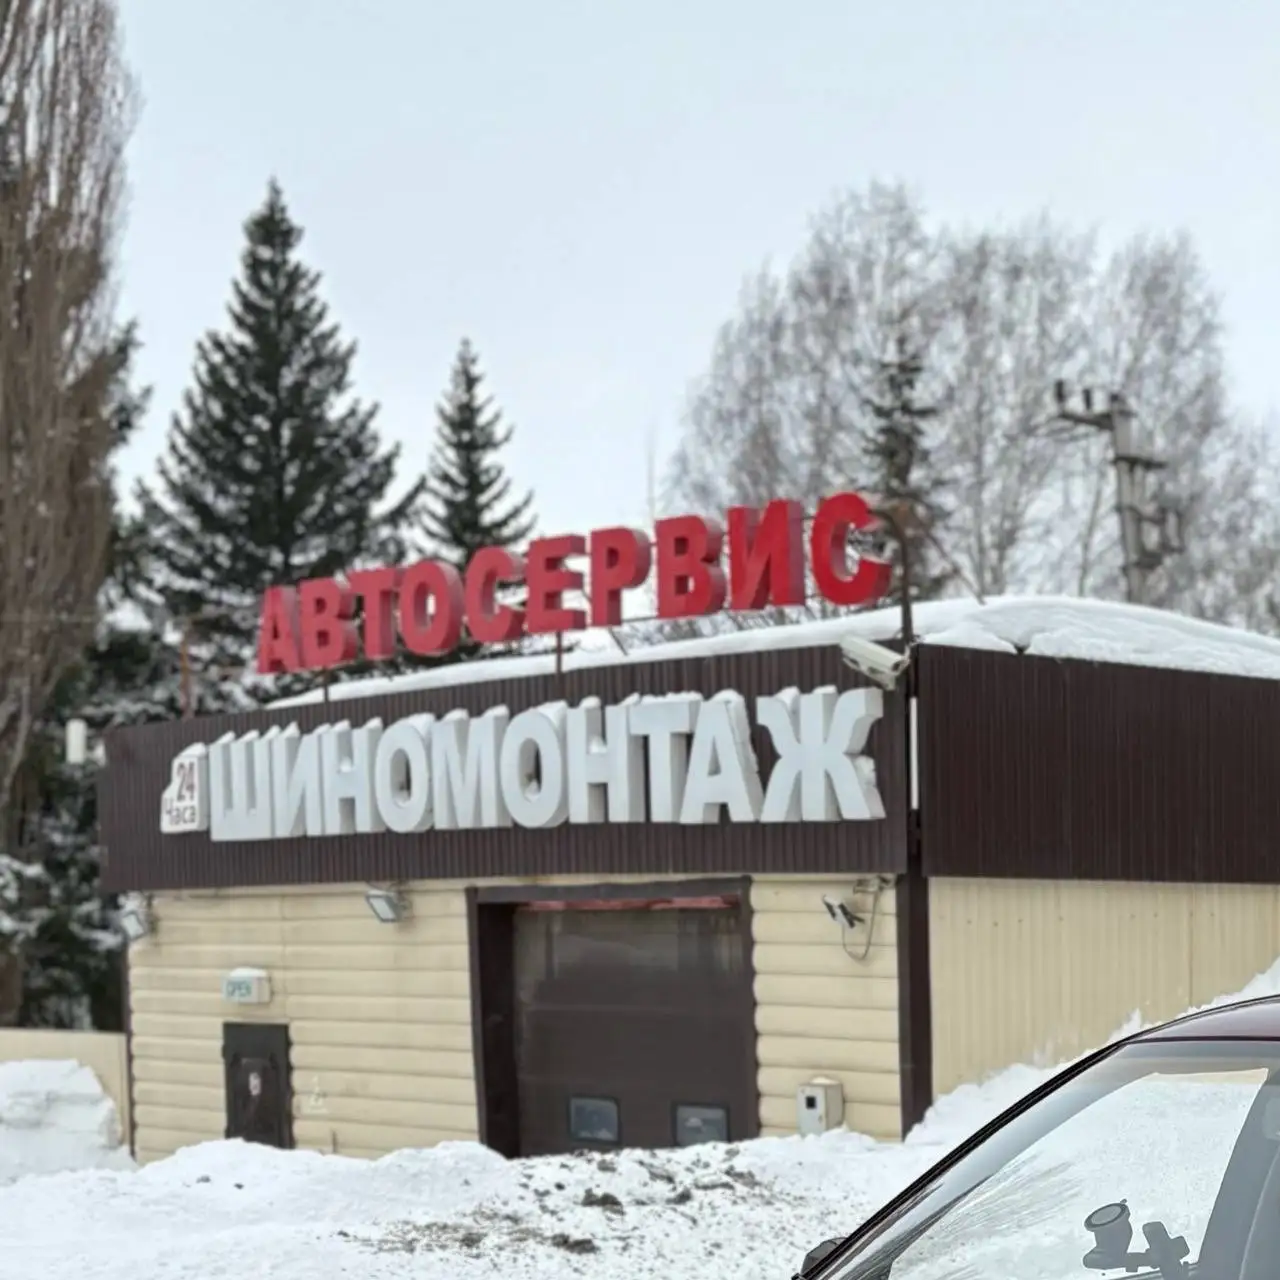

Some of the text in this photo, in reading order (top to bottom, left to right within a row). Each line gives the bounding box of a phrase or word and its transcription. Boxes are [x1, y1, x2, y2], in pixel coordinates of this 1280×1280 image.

[257, 491, 893, 674] АВТОСЕРВИС
[176, 761, 195, 802] 24
[209, 686, 886, 841] ШИНОМОНТАЖ
